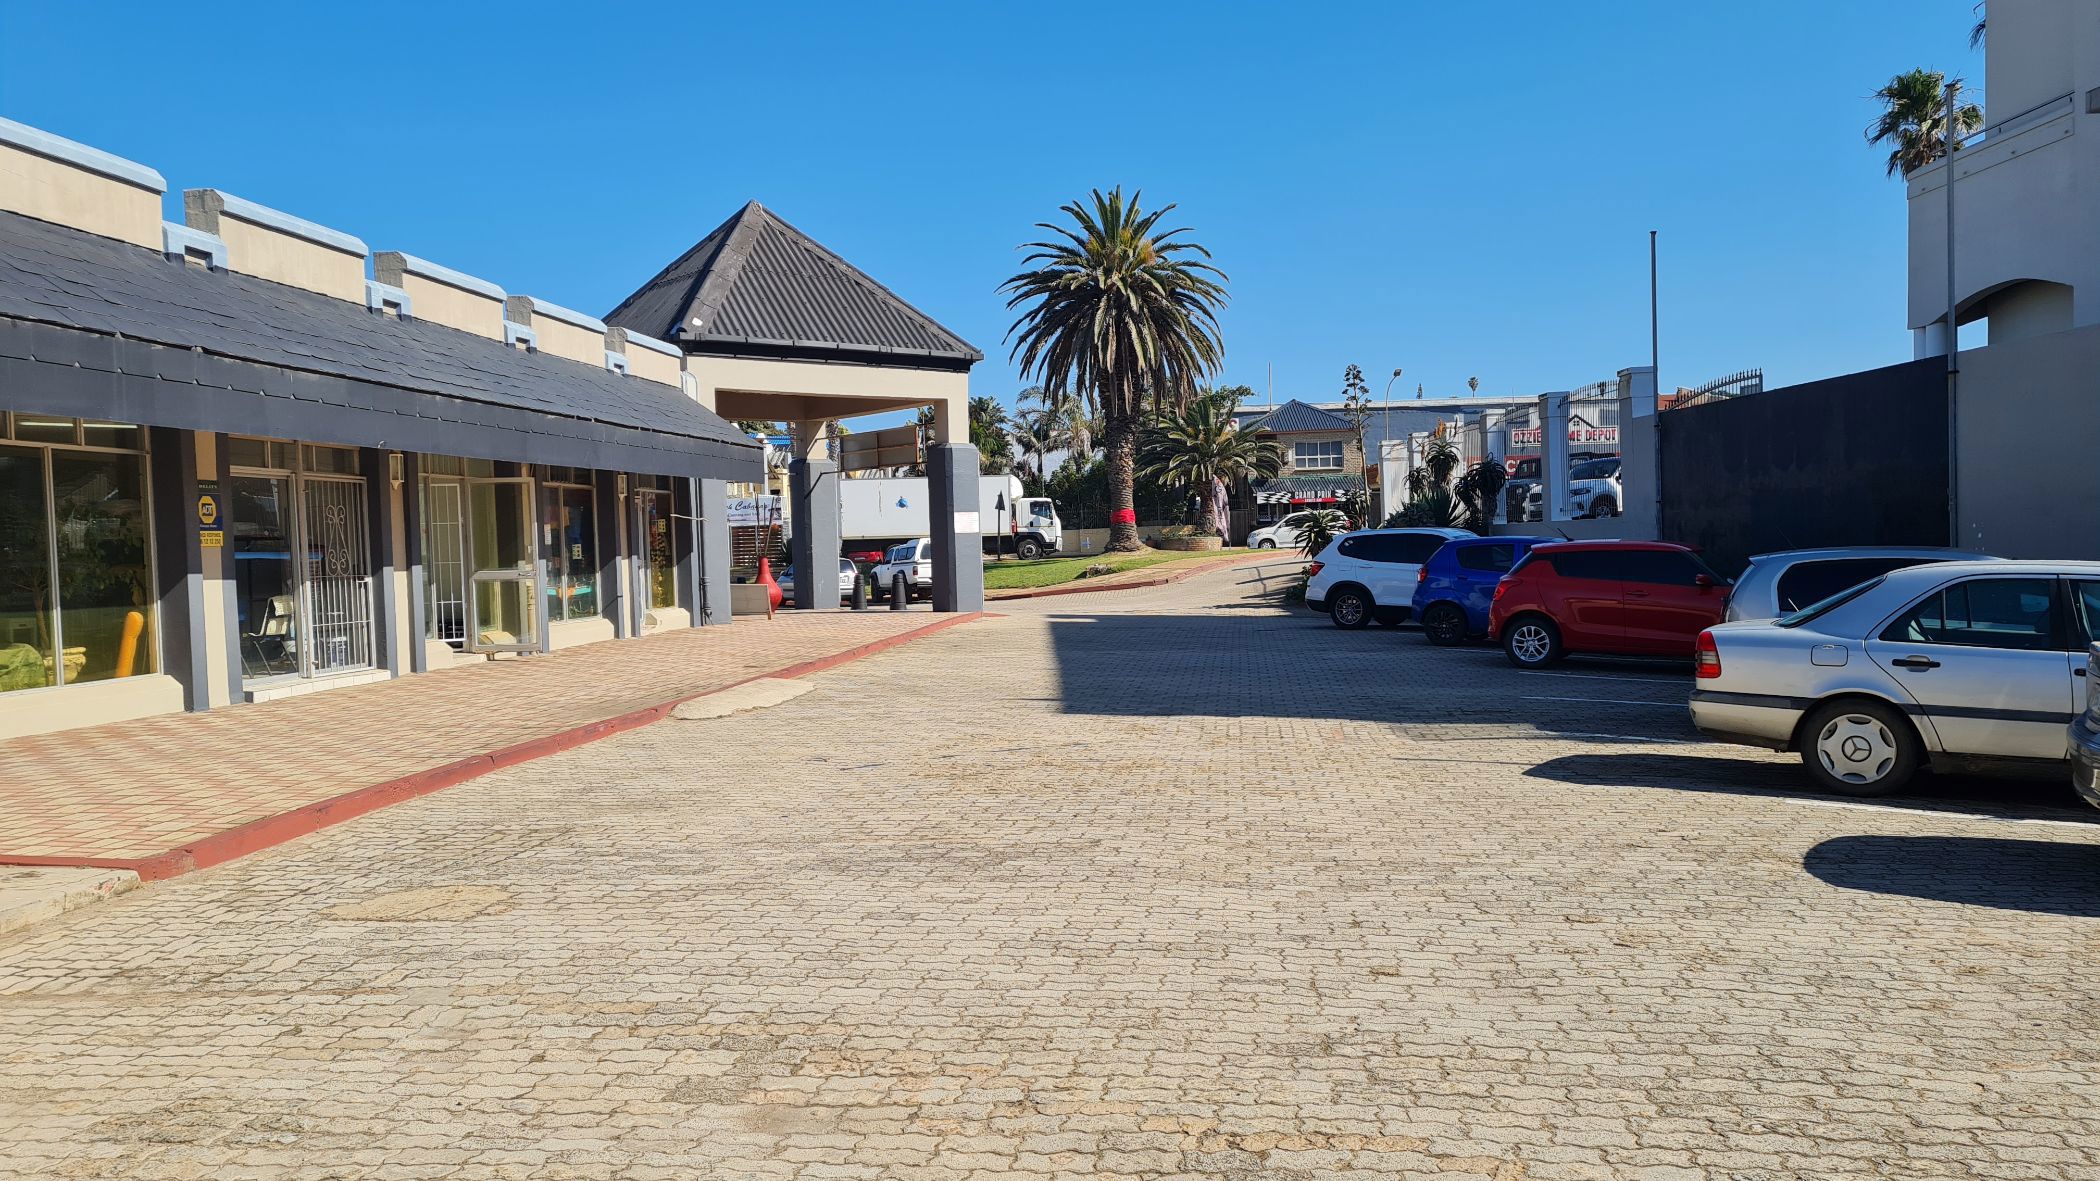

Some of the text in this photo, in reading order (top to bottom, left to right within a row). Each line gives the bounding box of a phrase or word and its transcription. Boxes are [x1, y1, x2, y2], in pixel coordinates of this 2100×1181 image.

[1585, 428, 1617, 441] DEPOT
[1294, 490, 1332, 498] GRAND PRIX
